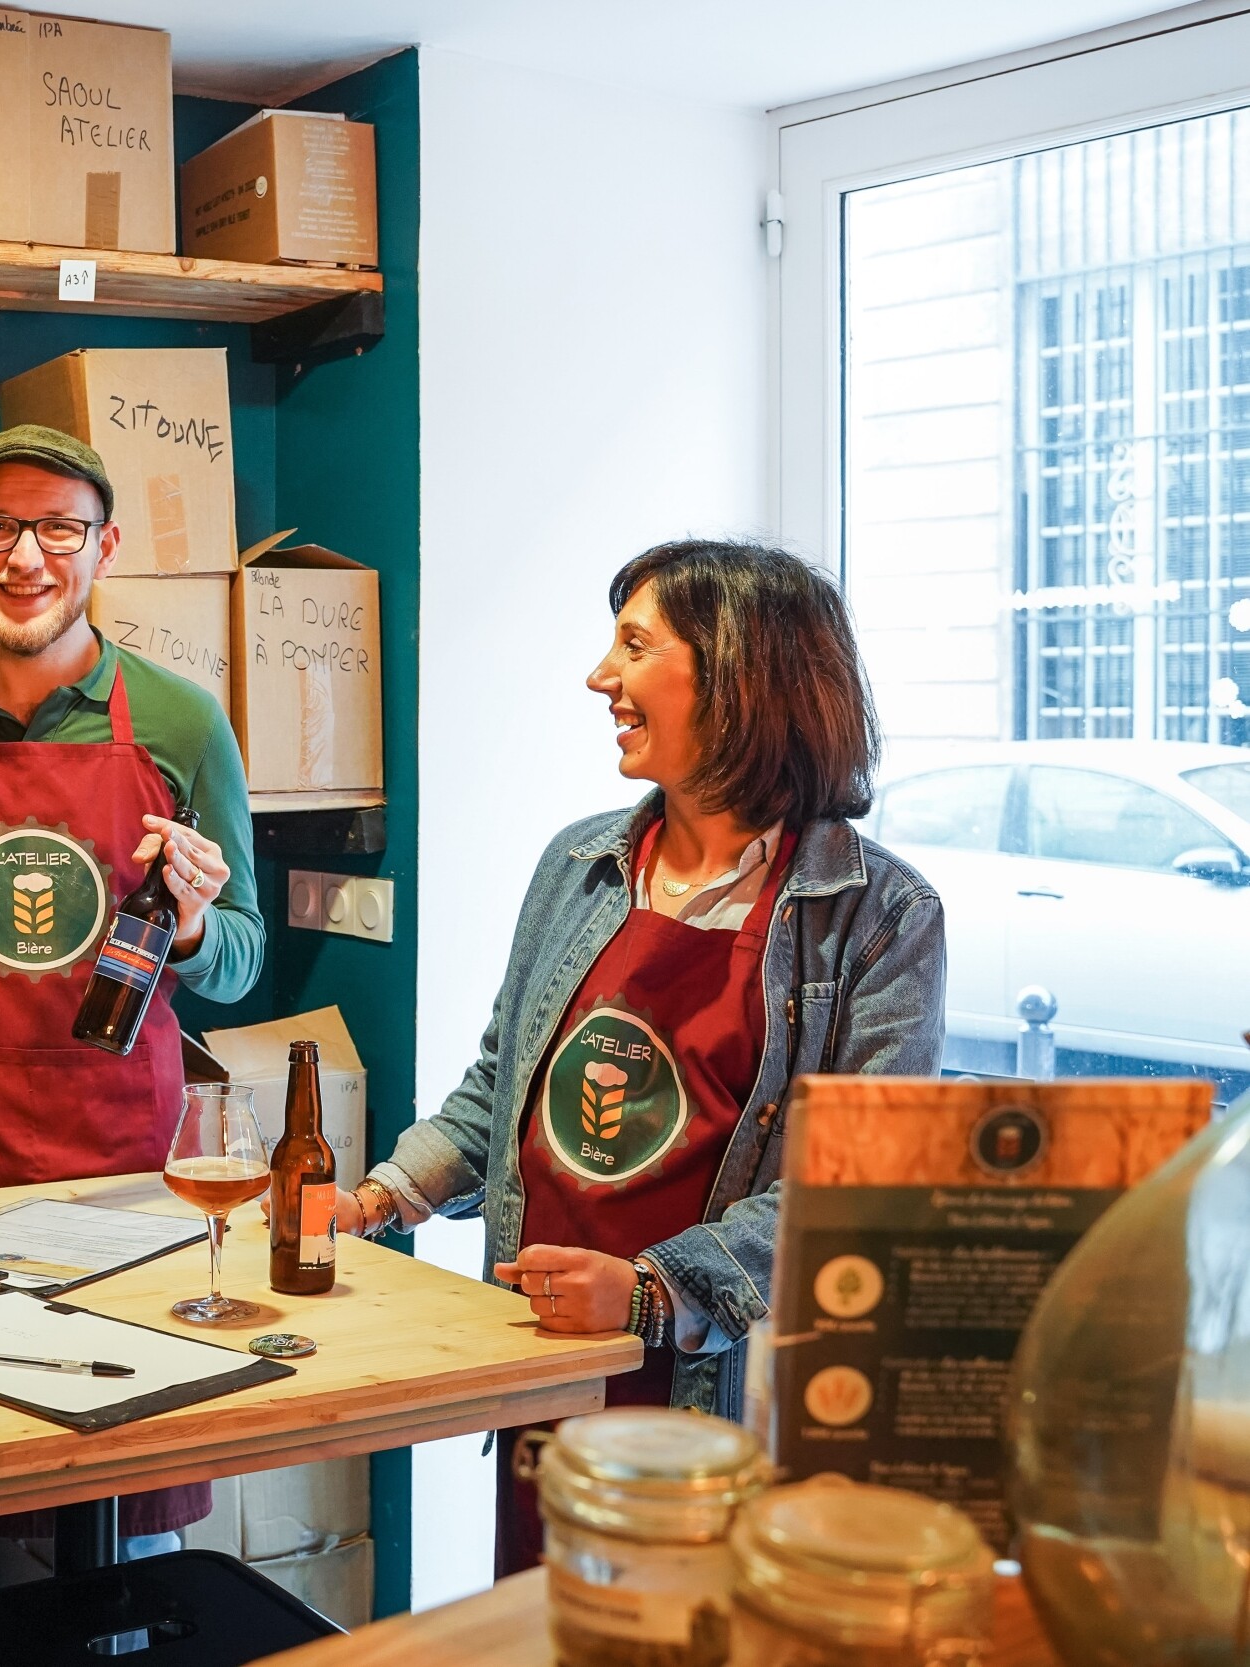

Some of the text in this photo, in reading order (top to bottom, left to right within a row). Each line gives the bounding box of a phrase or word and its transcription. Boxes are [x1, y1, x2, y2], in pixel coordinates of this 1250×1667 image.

[39, 22, 63, 39] IPA
[42, 71, 121, 110] SAOUL
[60, 115, 151, 151] ATELIER
[109, 395, 224, 463] ZITOUNE
[251, 571, 281, 589] Blonde
[259, 592, 364, 631] LA DURE
[114, 620, 228, 678] ZITOUNE
[281, 639, 370, 674] POMPER
[16, 941, 53, 955] Bière
[579, 1028, 652, 1062] L'ATELIER
[341, 1081, 359, 1093] IPA
[580, 1142, 615, 1166] Bière
